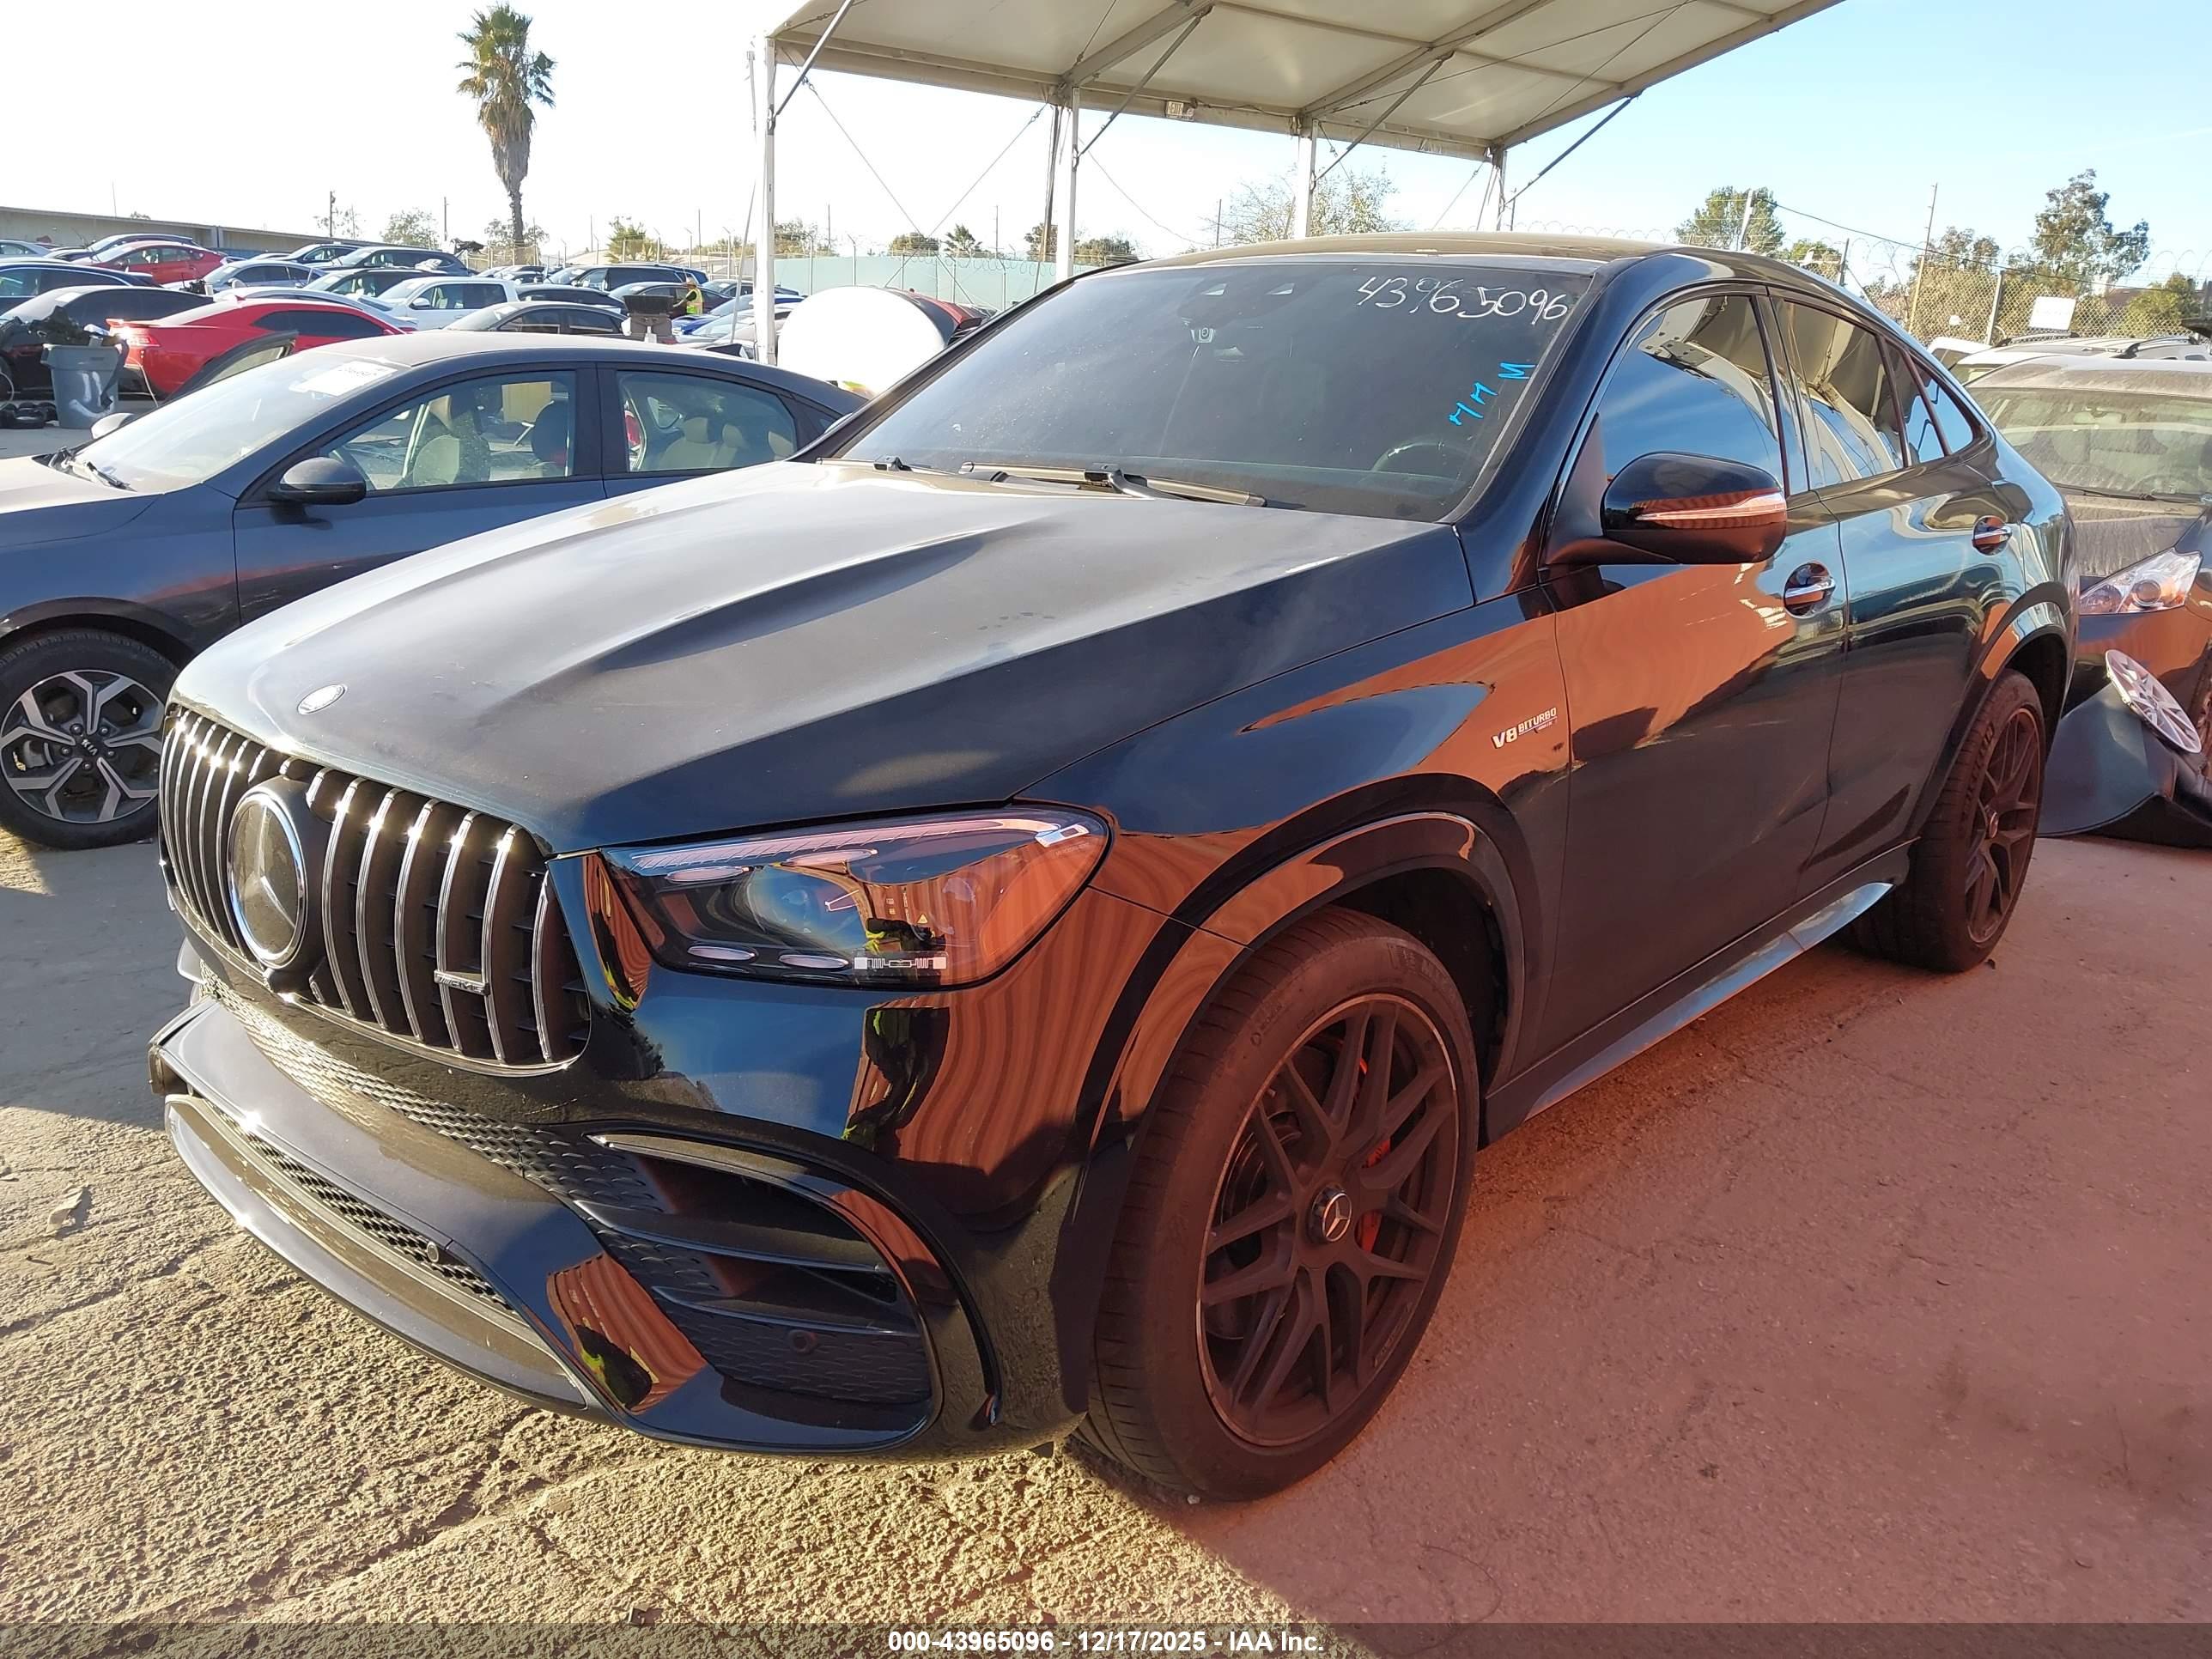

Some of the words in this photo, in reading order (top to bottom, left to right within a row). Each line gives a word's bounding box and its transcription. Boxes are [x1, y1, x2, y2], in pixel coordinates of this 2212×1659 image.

[1357, 276, 1569, 325] 43965096
[80, 738, 98, 756] KIA
[1492, 726, 1518, 749] V8
[1517, 707, 1557, 733] BITURBO
